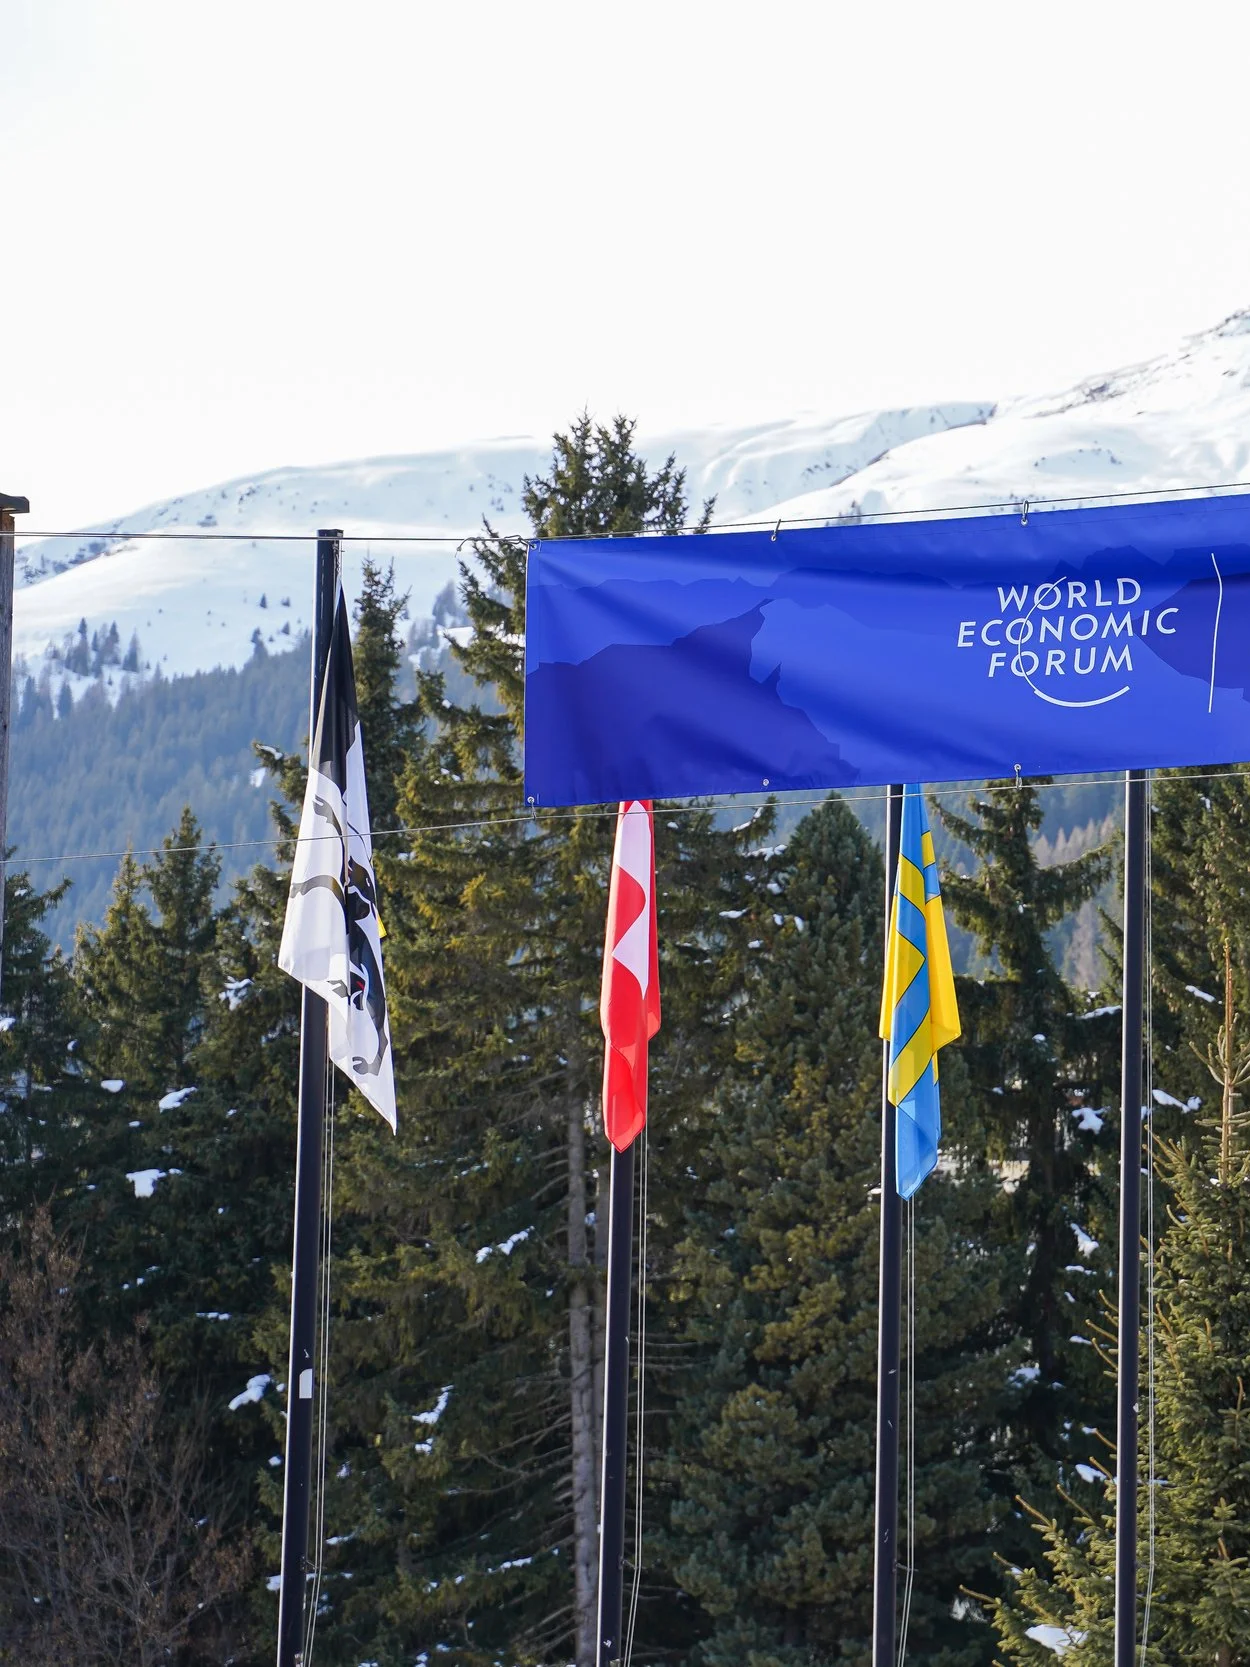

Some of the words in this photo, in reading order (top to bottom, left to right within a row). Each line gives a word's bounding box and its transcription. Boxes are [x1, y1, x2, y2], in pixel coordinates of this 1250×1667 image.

[997, 577, 1142, 613] WORLD
[957, 607, 1180, 648] ECONOMIC
[987, 643, 1134, 678] FORUM
